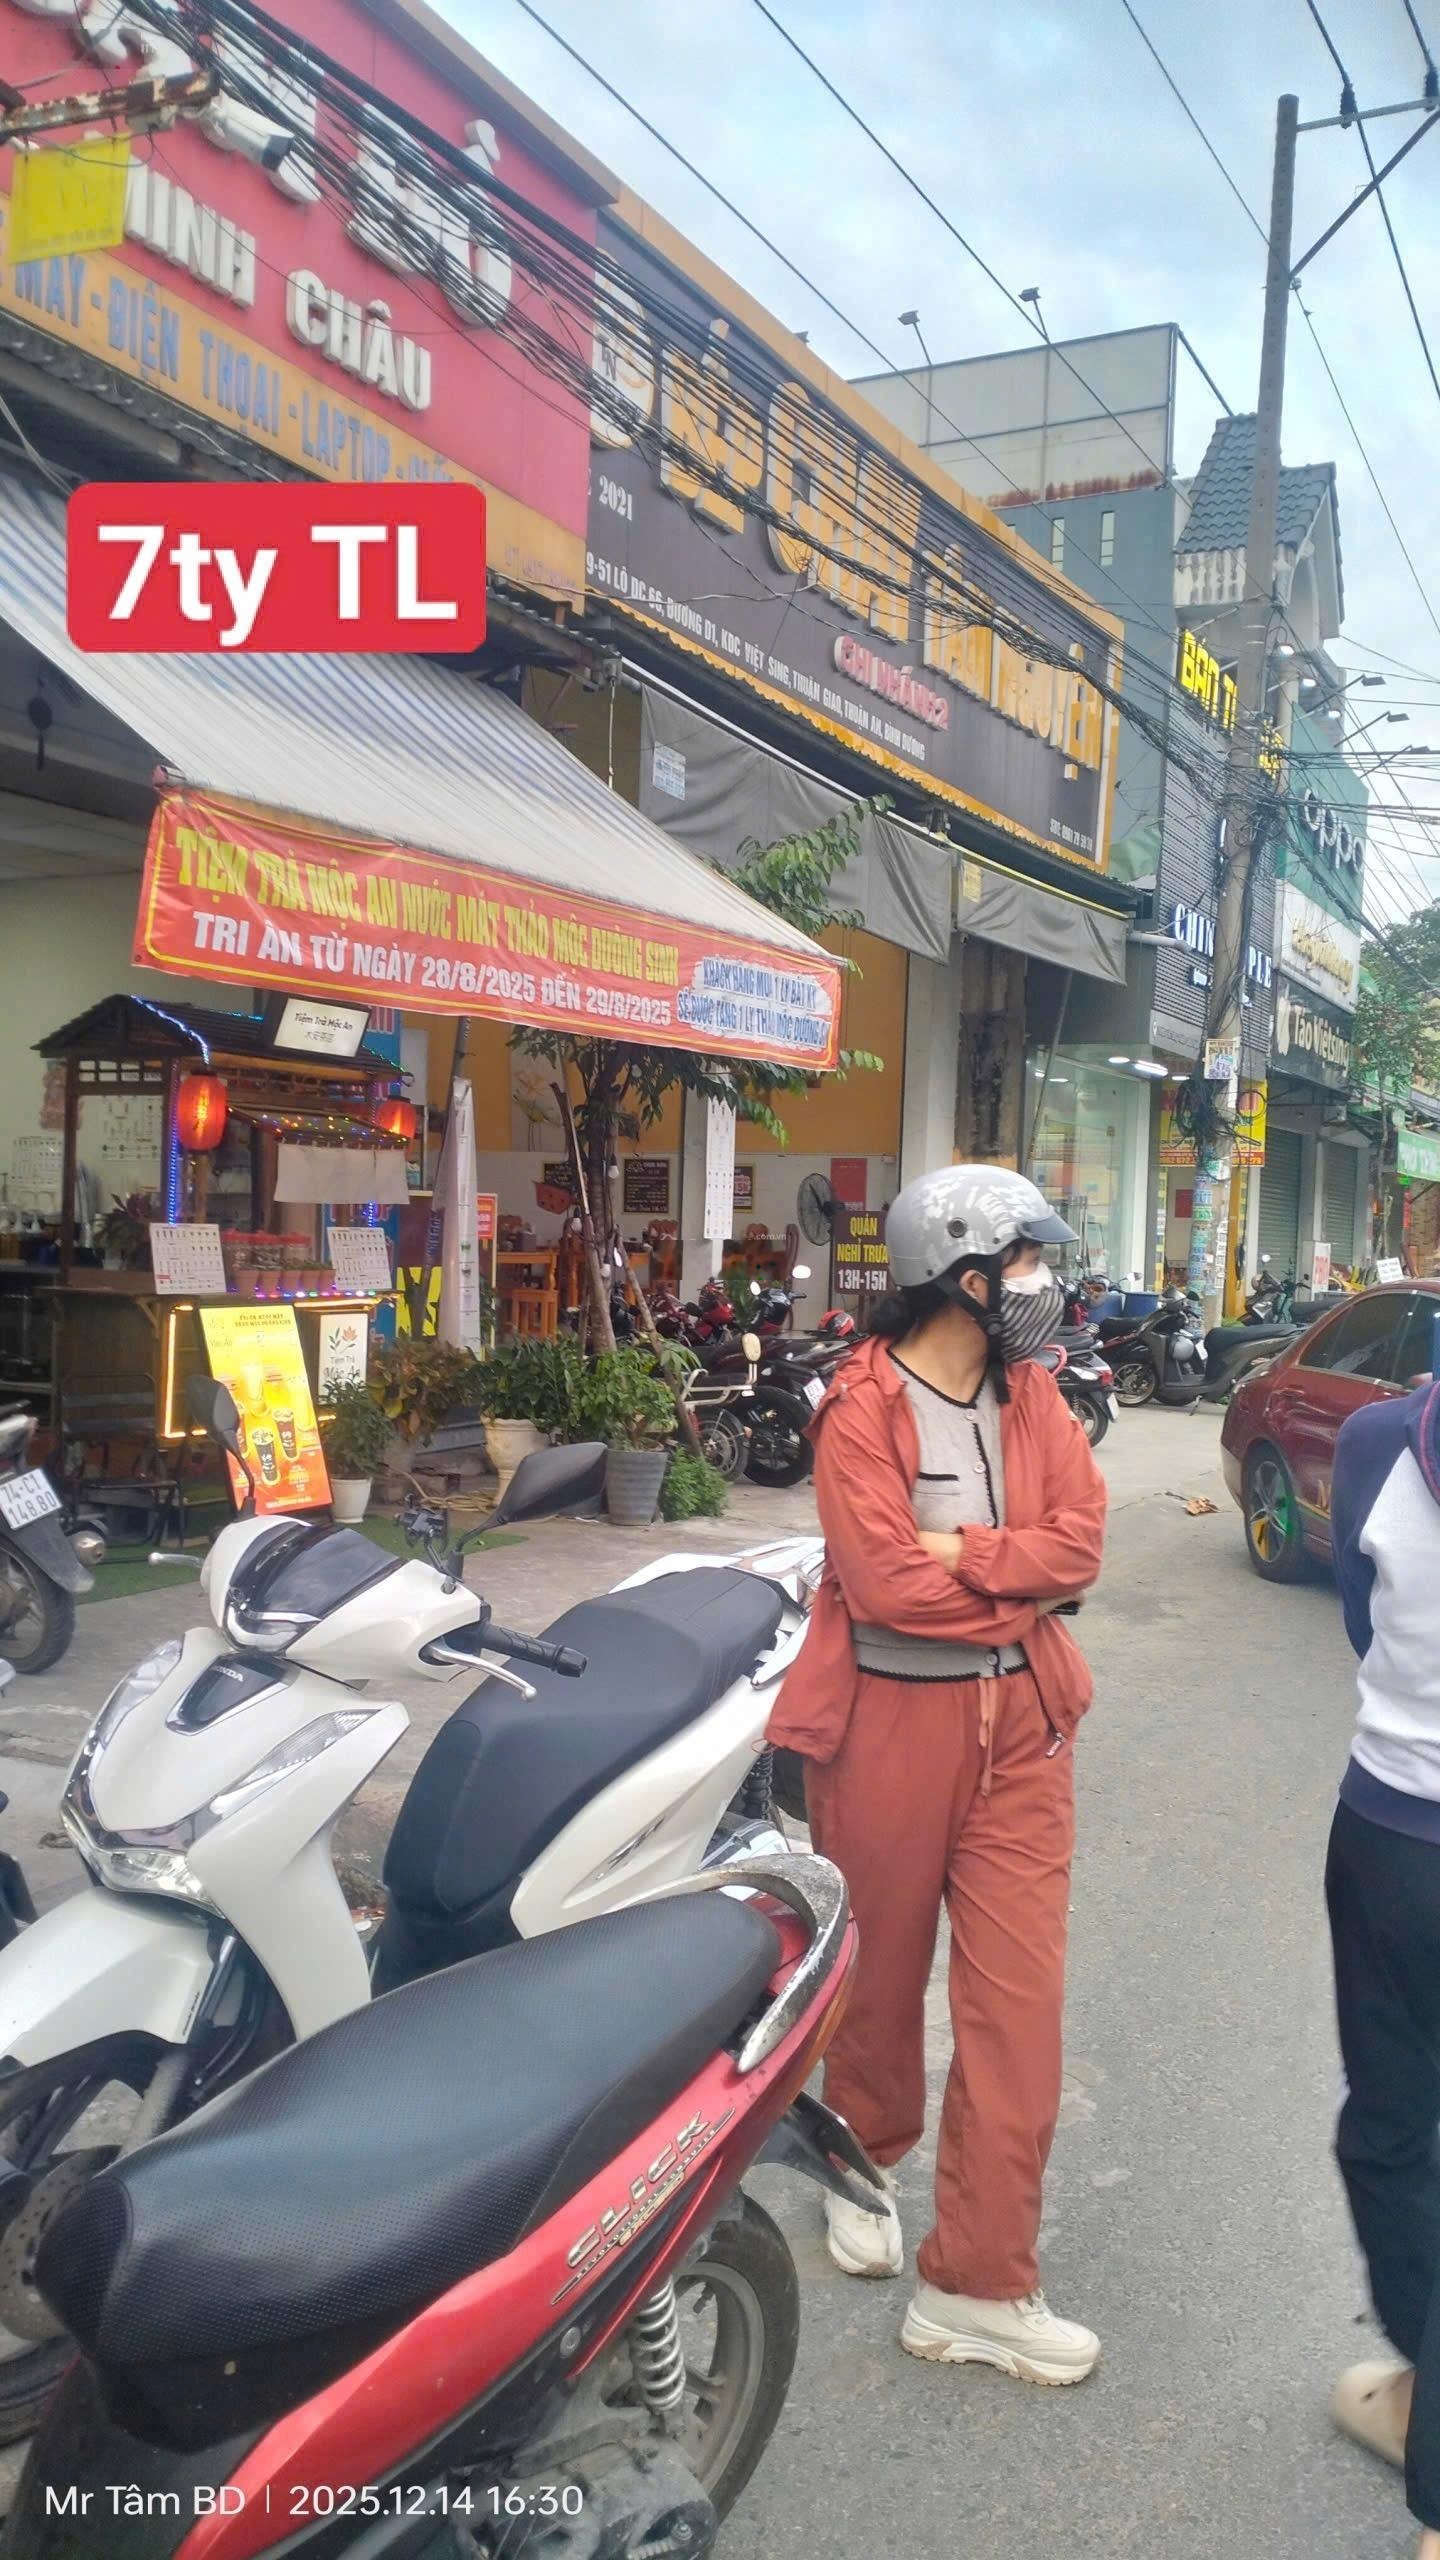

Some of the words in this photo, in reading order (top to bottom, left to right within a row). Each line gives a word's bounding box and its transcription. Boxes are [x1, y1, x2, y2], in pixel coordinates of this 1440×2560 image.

[108, 279, 180, 382] ĐIỆN
[199, 329, 280, 438] THOẠI
[302, 391, 391, 482] LAPTOP
[286, 269, 431, 412] CHÂU
[599, 474, 633, 522] 2021
[585, 551, 612, 585] 9-51
[613, 565, 628, 594] LÔ
[631, 575, 646, 601] DC
[704, 618, 718, 648] D1,
[721, 628, 741, 657] KDC
[744, 640, 765, 673] VIỆT
[768, 656, 792, 688] SING,
[792, 671, 820, 703] THUẬN
[823, 687, 844, 718] GIAO,
[1180, 628, 1221, 719] BÁN
[176, 825, 249, 904] TIỆM
[253, 848, 308, 912] TRÀ
[305, 857, 362, 930] MỘC
[366, 874, 398, 930] AN
[401, 878, 452, 940] NƯỚC
[456, 890, 499, 949] MÁT
[503, 898, 549, 960] THẢO
[552, 912, 588, 975] MỘC
[646, 939, 679, 988] SINH
[193, 910, 250, 956] TRI
[309, 931, 349, 973] TỪ
[352, 942, 416, 984] NGÀY
[421, 955, 536, 1004] 28/8/2025
[541, 971, 581, 1011] ĐẾN
[586, 985, 672, 1026] 29/8/2025
[837, 1238, 862, 1263] NGHỈ
[863, 1243, 889, 1264] TRƯA
[849, 1213, 877, 1237] QUÁN
[837, 1269, 888, 1292] 13H-15H
[1, 1473, 42, 1503] 74-C1
[566, 2110, 711, 2270] CLICK
